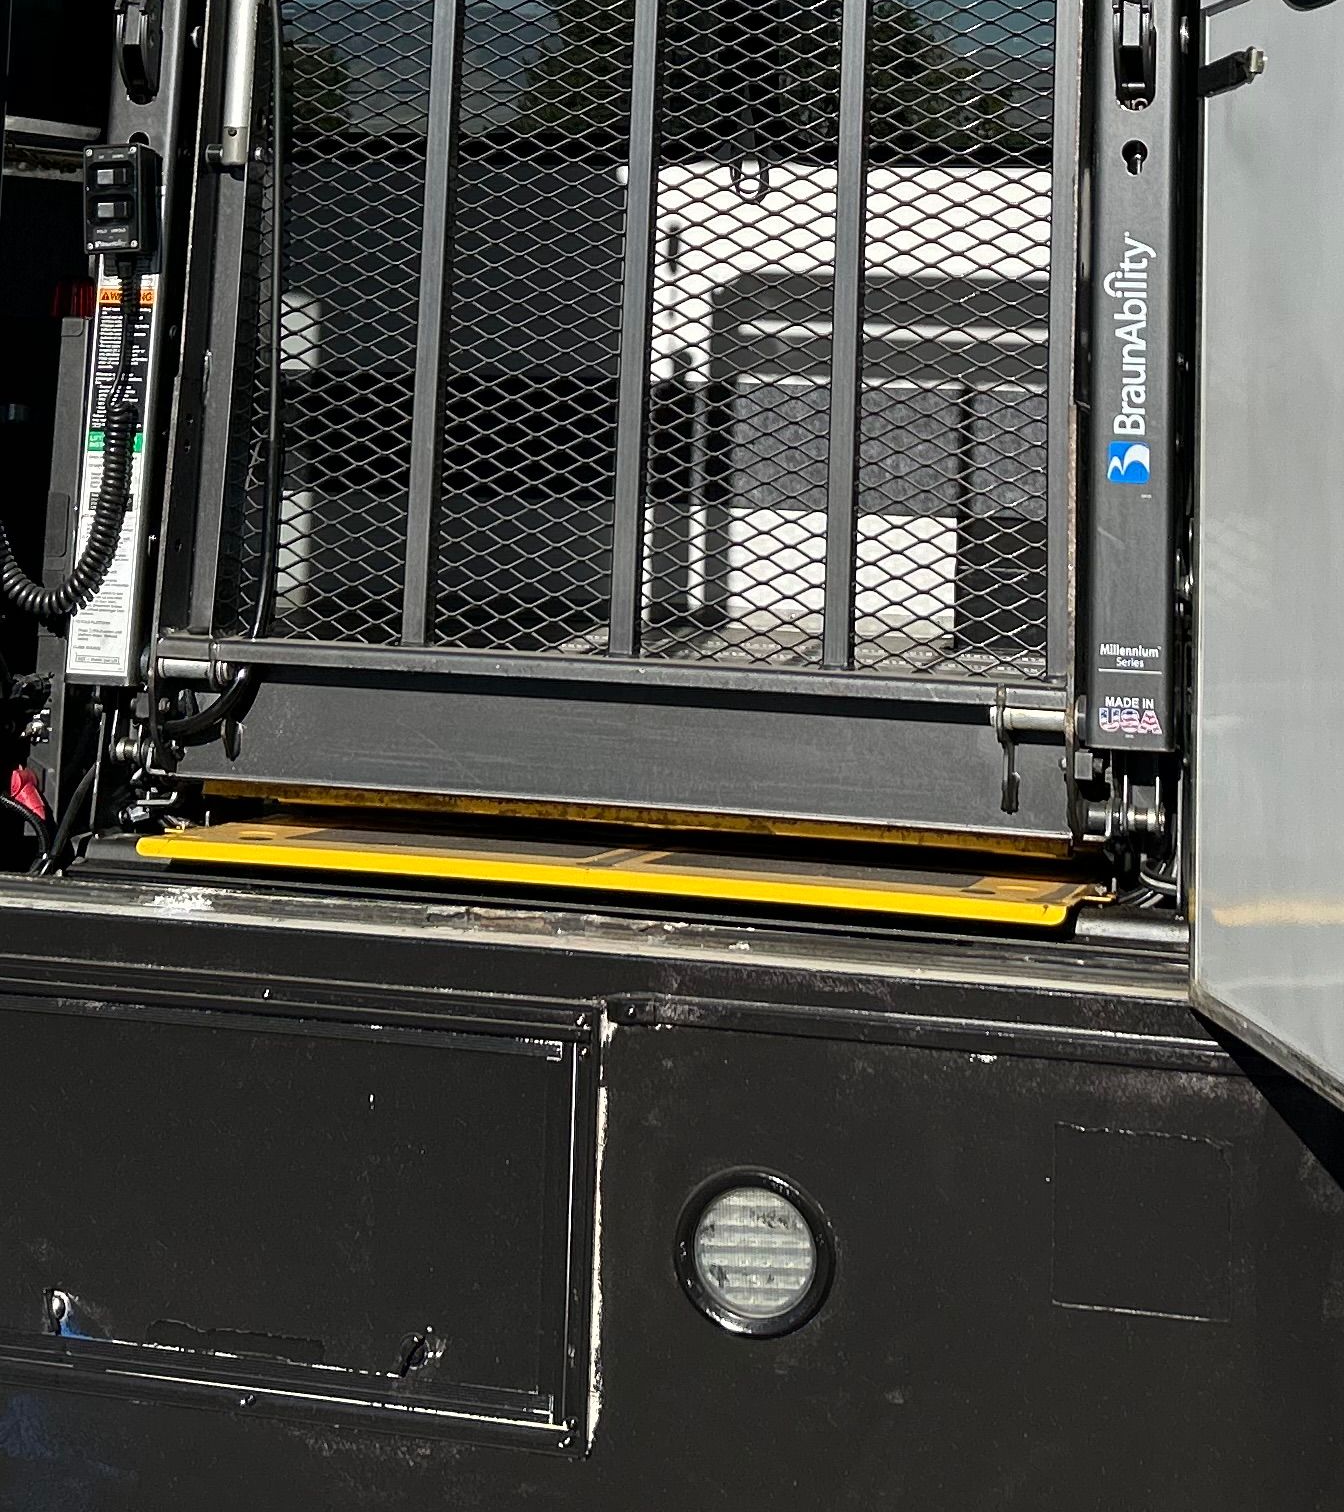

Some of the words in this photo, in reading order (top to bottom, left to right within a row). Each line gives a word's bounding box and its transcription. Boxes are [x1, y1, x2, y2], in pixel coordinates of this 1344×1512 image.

[1103, 232, 1157, 436] BraunAbility
[1100, 644, 1160, 658] Millennium
[1116, 656, 1144, 668] Series
[1105, 696, 1139, 708] MADE
[1142, 698, 1154, 709] IN
[1099, 707, 1163, 735] USA
